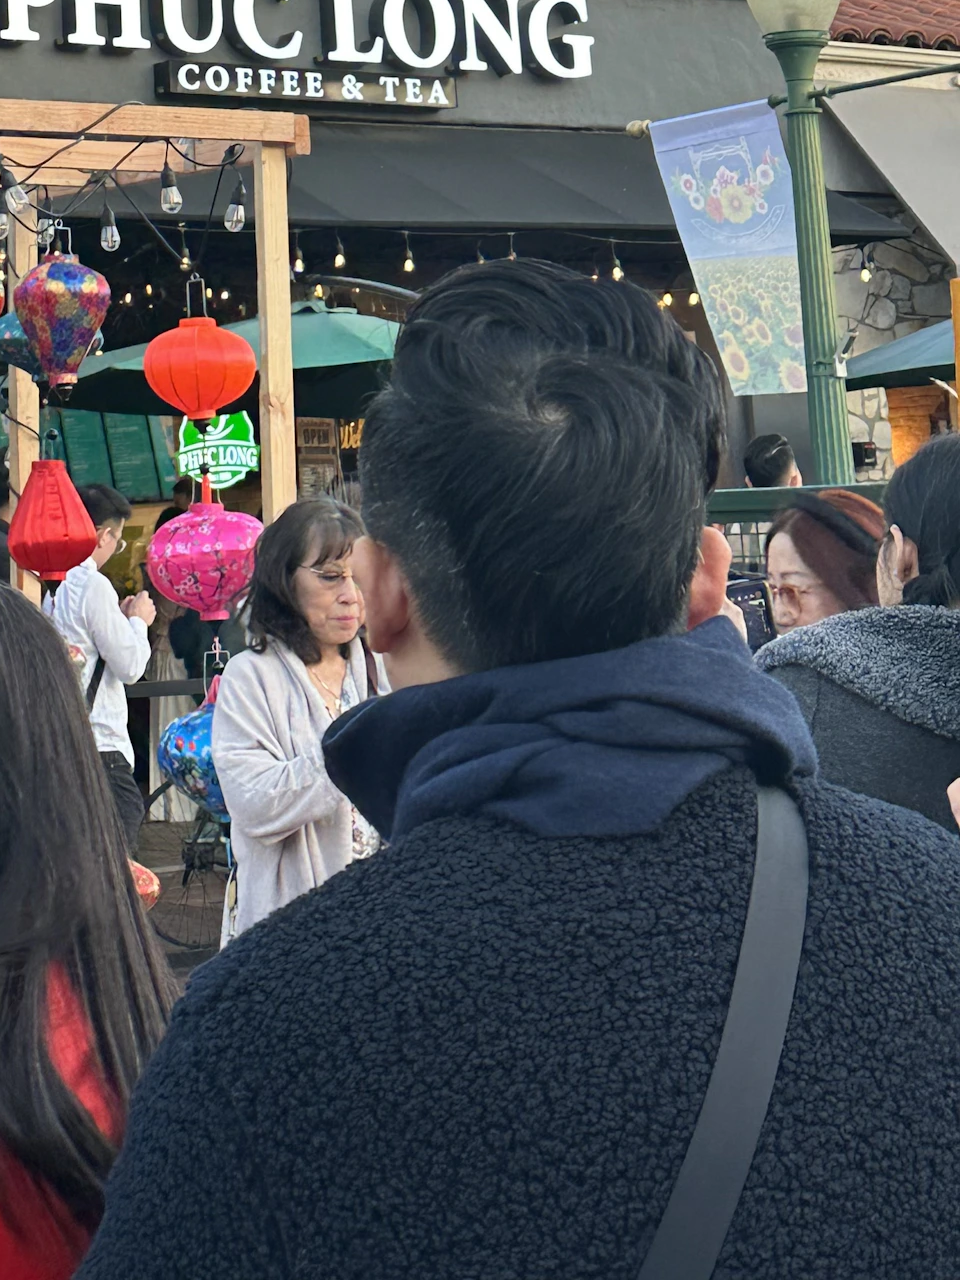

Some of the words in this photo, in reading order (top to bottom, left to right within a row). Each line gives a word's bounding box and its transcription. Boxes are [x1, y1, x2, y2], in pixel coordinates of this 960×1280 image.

[177, 63, 325, 98] COFFEE
[341, 74, 364, 100] &
[379, 76, 449, 105] TEA
[218, 446, 258, 467] LONG
